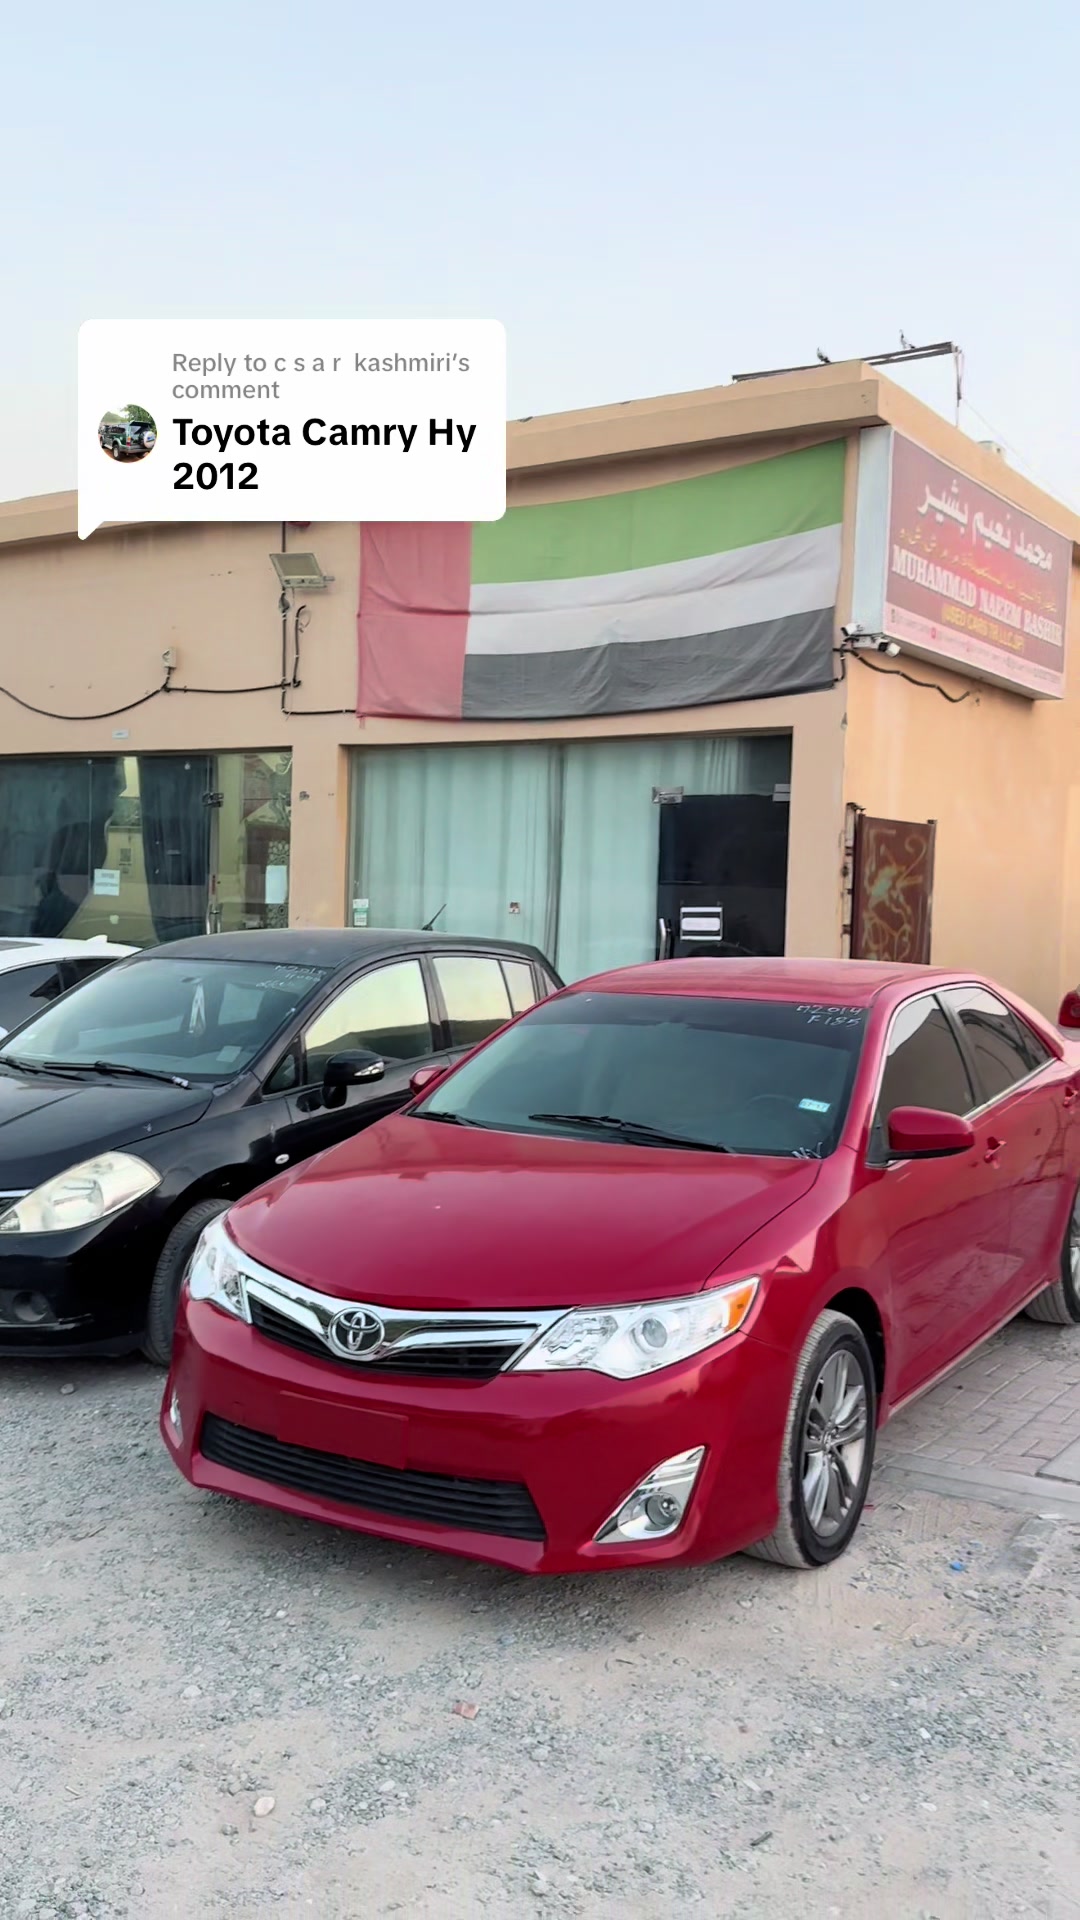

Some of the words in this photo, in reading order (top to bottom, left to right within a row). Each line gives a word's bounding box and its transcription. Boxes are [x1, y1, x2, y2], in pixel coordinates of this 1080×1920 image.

[917, 479, 969, 534] بشير
[972, 511, 1012, 548] نعيم
[1014, 531, 1053, 571] محمد
[891, 545, 977, 609] MUHAMMAD
[979, 586, 1022, 629] NAEEM
[1023, 605, 1063, 648] BASHIR
